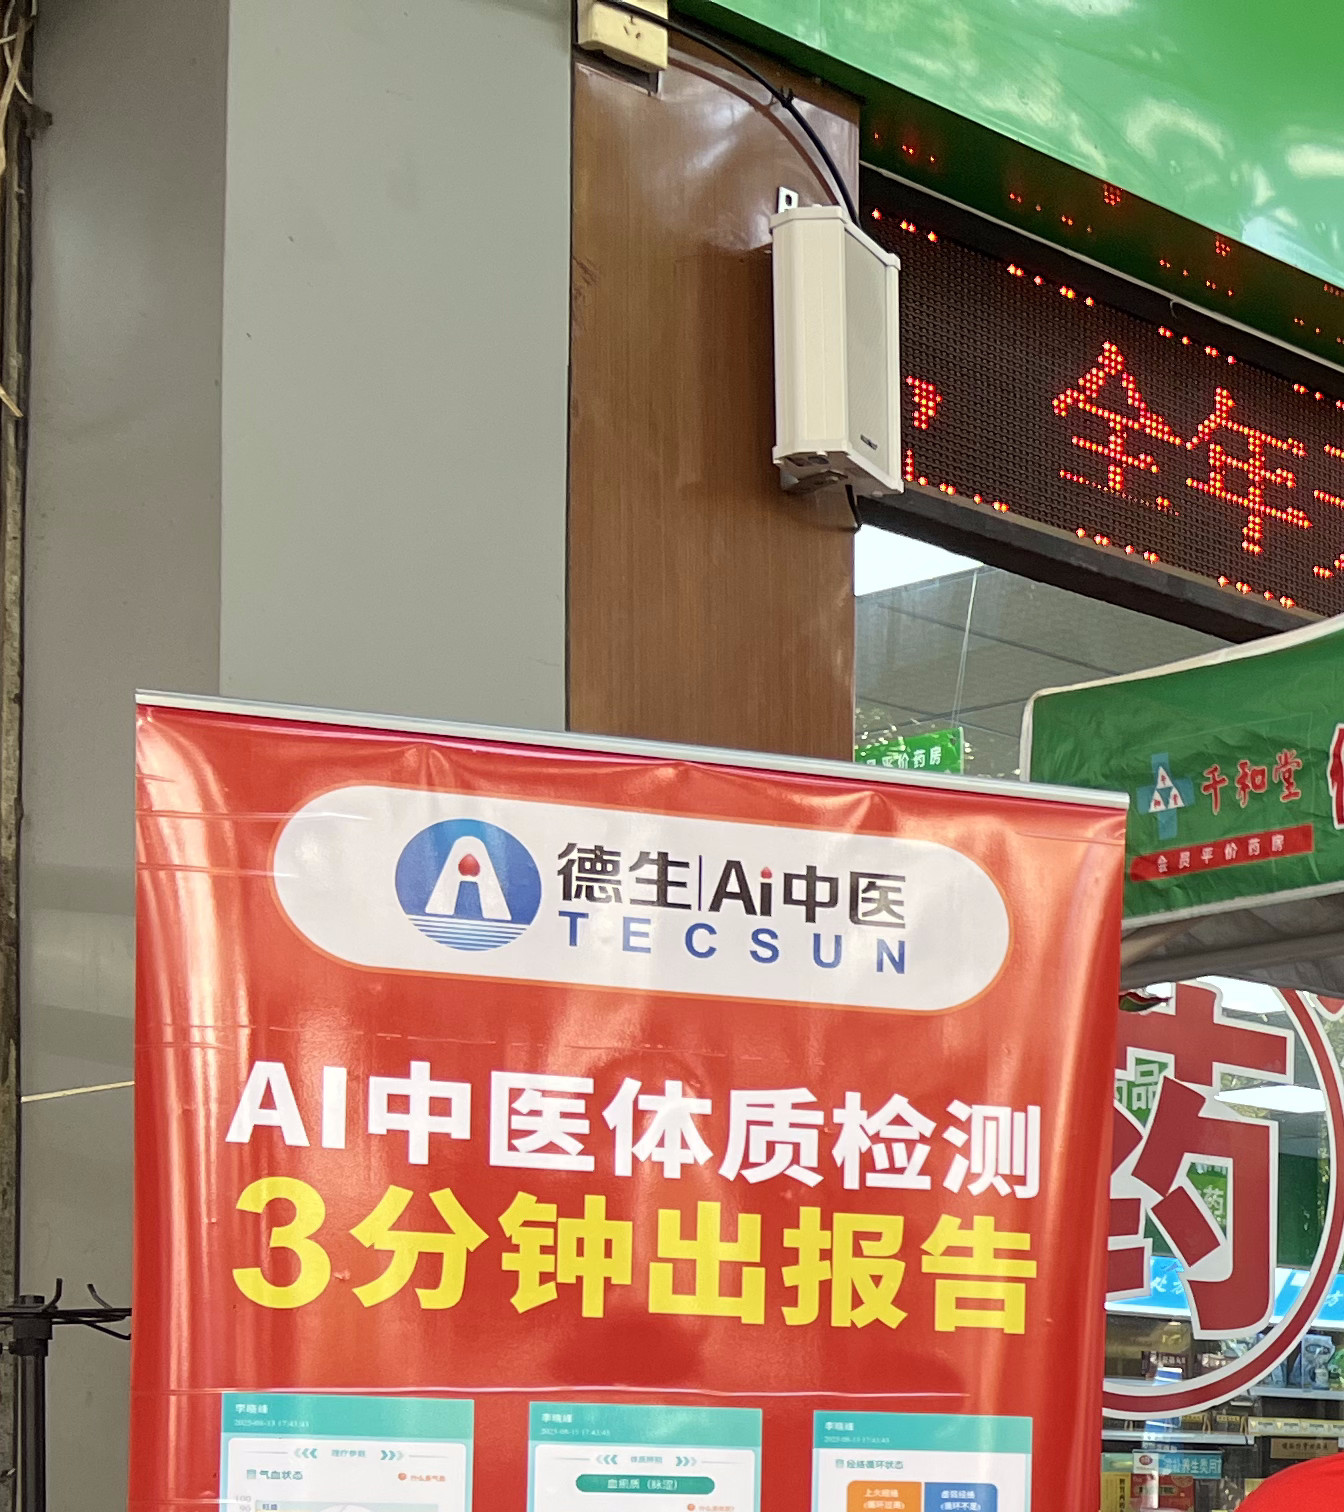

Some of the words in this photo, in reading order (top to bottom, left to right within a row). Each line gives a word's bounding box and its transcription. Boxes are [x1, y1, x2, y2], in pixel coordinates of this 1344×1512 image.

[1201, 748, 1303, 816] 千和堂
[558, 909, 910, 977] TECSUN
[225, 1060, 1043, 1199] AI中医体质检测
[231, 1176, 1039, 1334] 3分钟出报告
